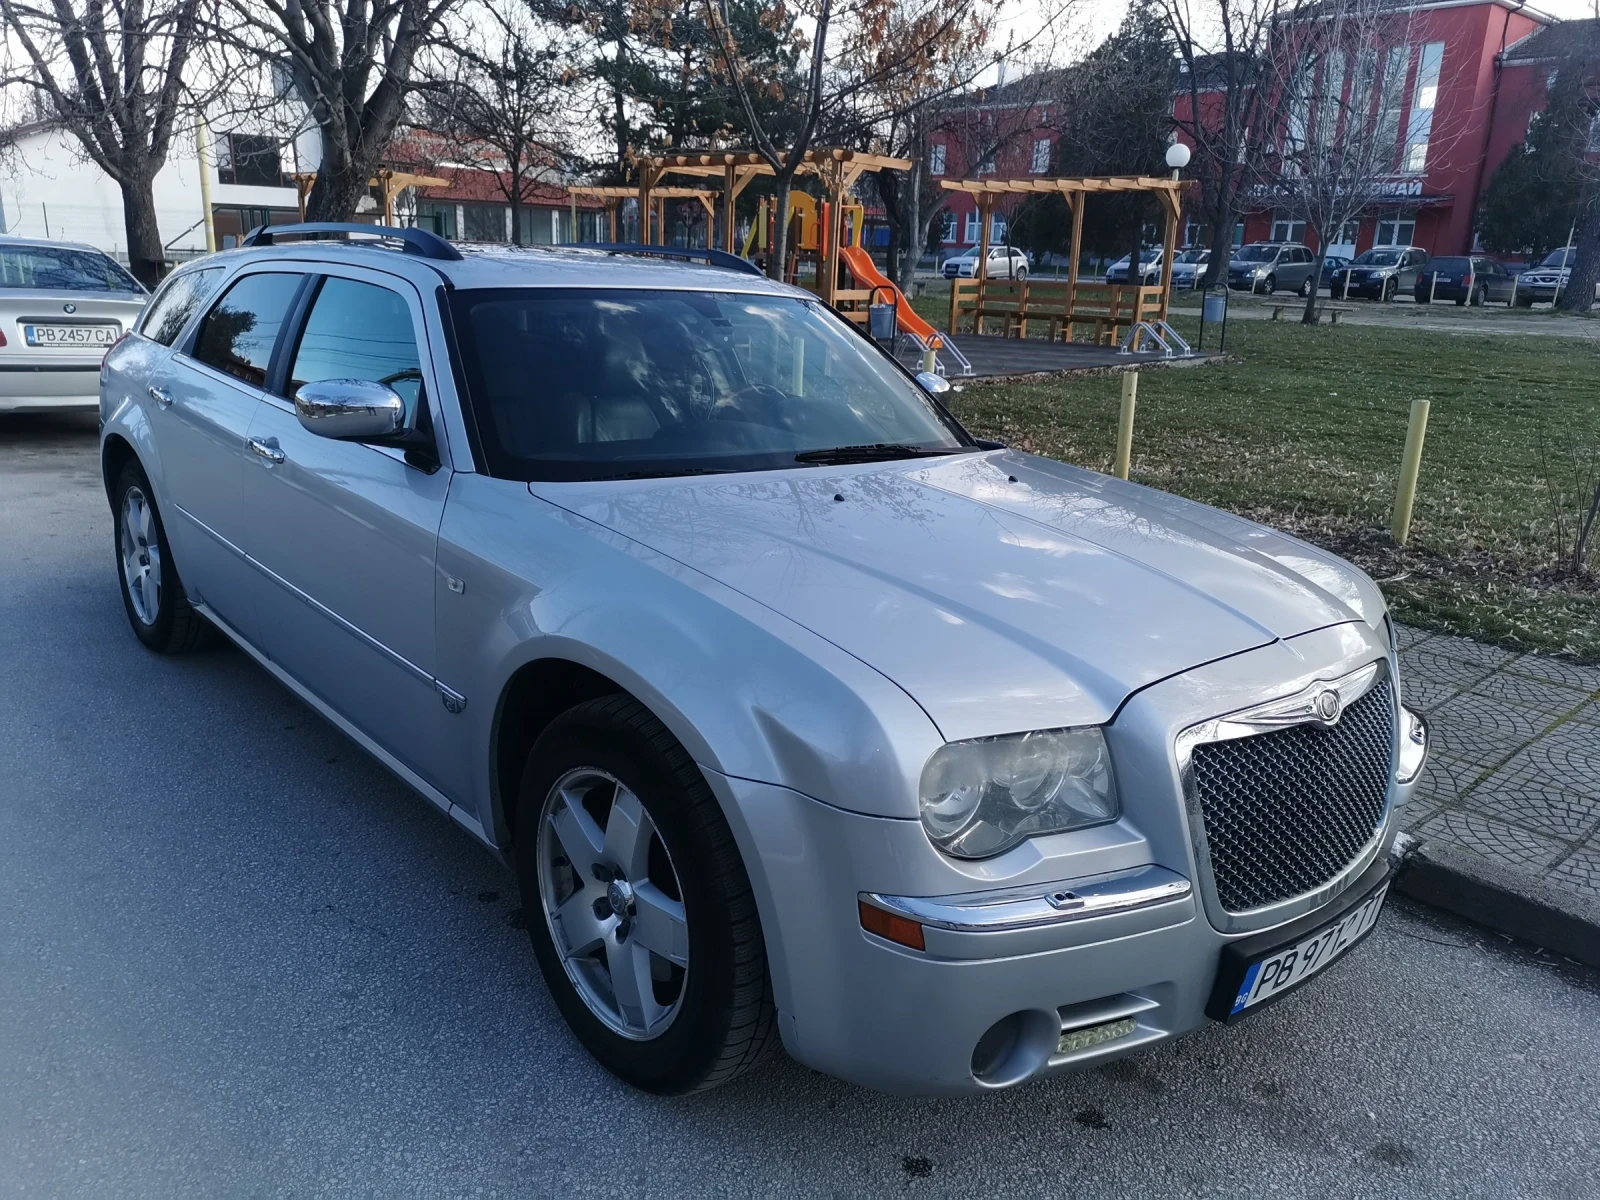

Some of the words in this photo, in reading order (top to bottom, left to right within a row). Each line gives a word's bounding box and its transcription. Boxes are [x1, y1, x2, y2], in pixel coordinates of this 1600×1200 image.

[36, 328, 56, 341] PB
[58, 329, 92, 342] 2457
[95, 331, 114, 342] CA
[1253, 951, 1298, 999] PB
[1235, 992, 1248, 1006] BG
